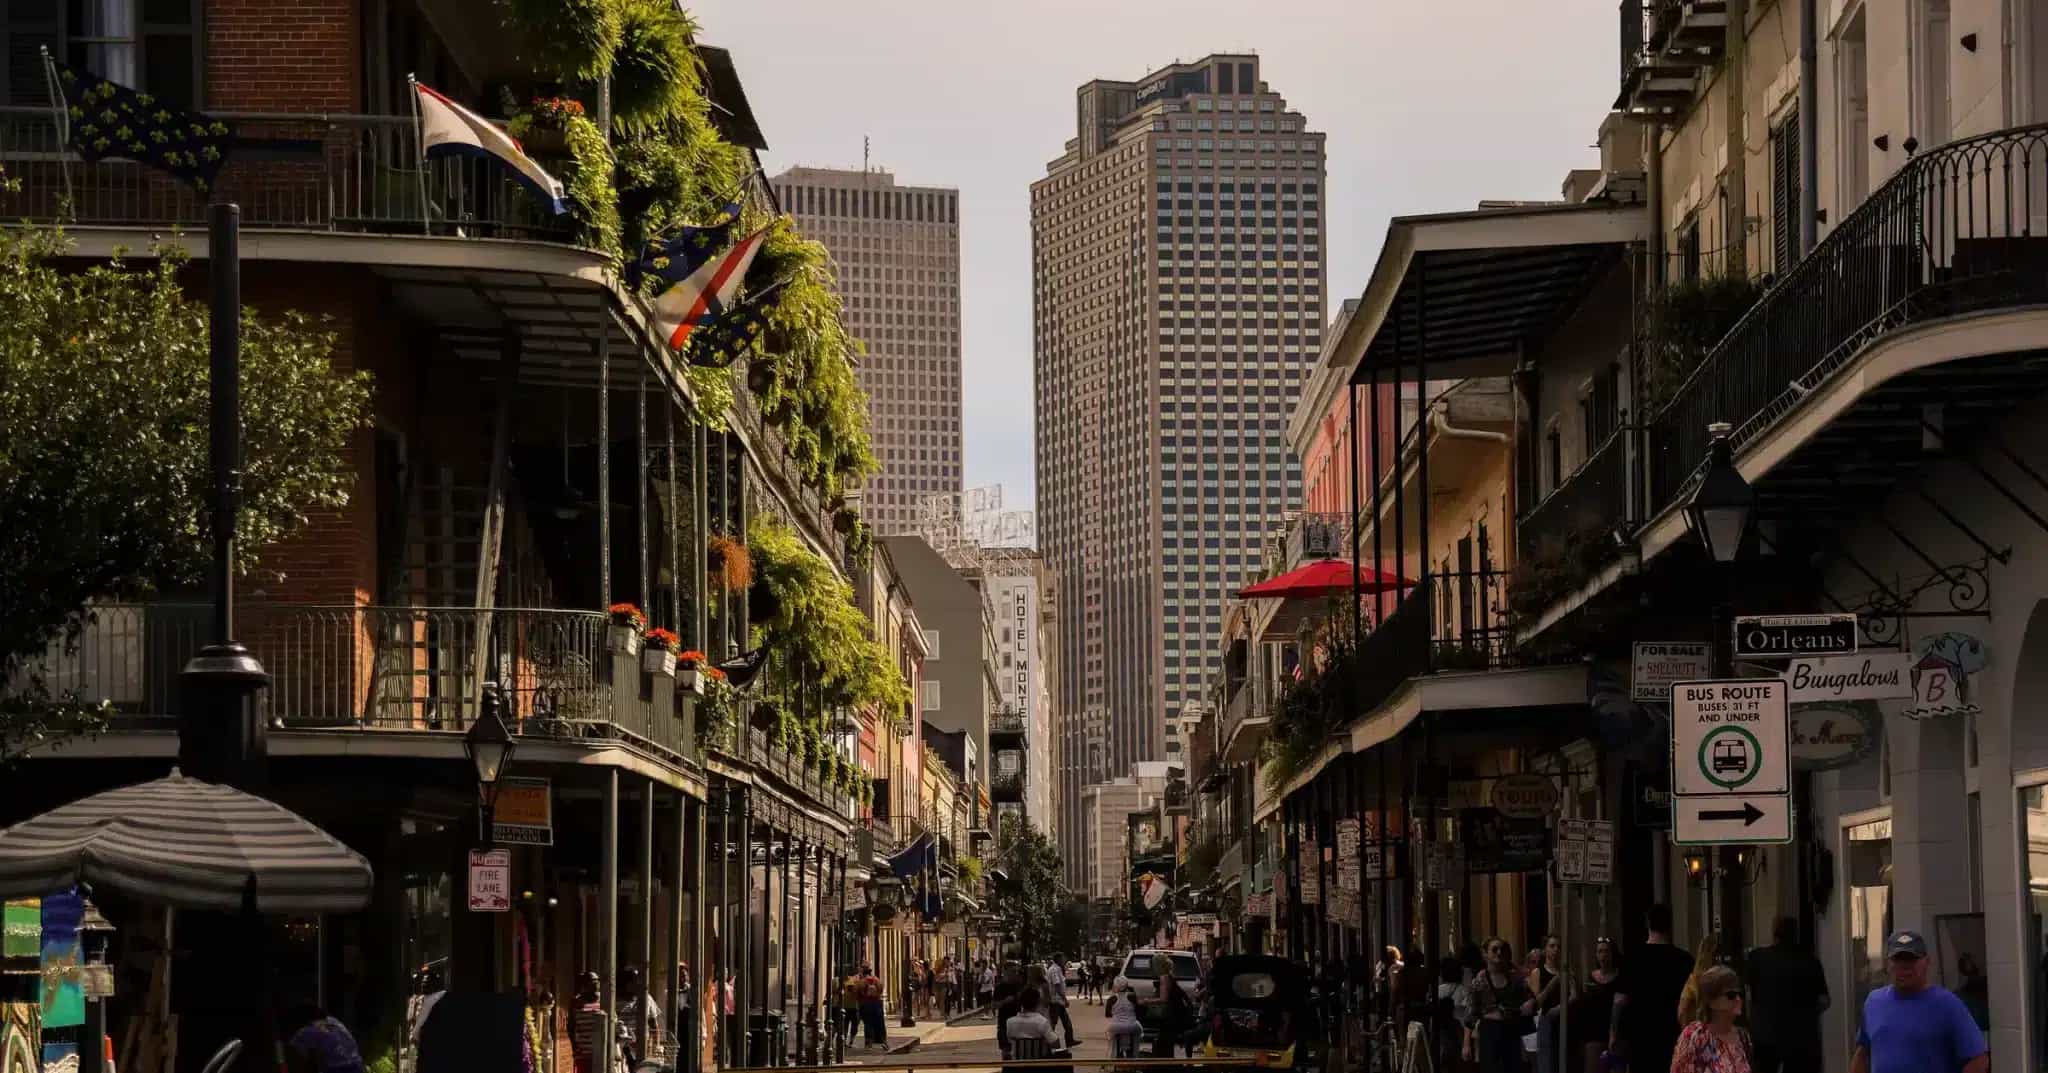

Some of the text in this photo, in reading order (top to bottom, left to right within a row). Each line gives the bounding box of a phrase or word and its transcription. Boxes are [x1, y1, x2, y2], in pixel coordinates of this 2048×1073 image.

[1016, 594, 1026, 651] HOTEL
[1746, 629, 1846, 650] Orleans
[1642, 647, 1704, 655] FOR SALE
[1793, 660, 1898, 695] Bungalows
[1927, 673, 1946, 702] B
[1687, 687, 1771, 701] BUS ROUTE
[1698, 702, 1759, 712] BUSES 31 FT
[1699, 713, 1760, 722] AND UNDER
[480, 870, 501, 880] FIRE
[478, 883, 501, 893] LANE
